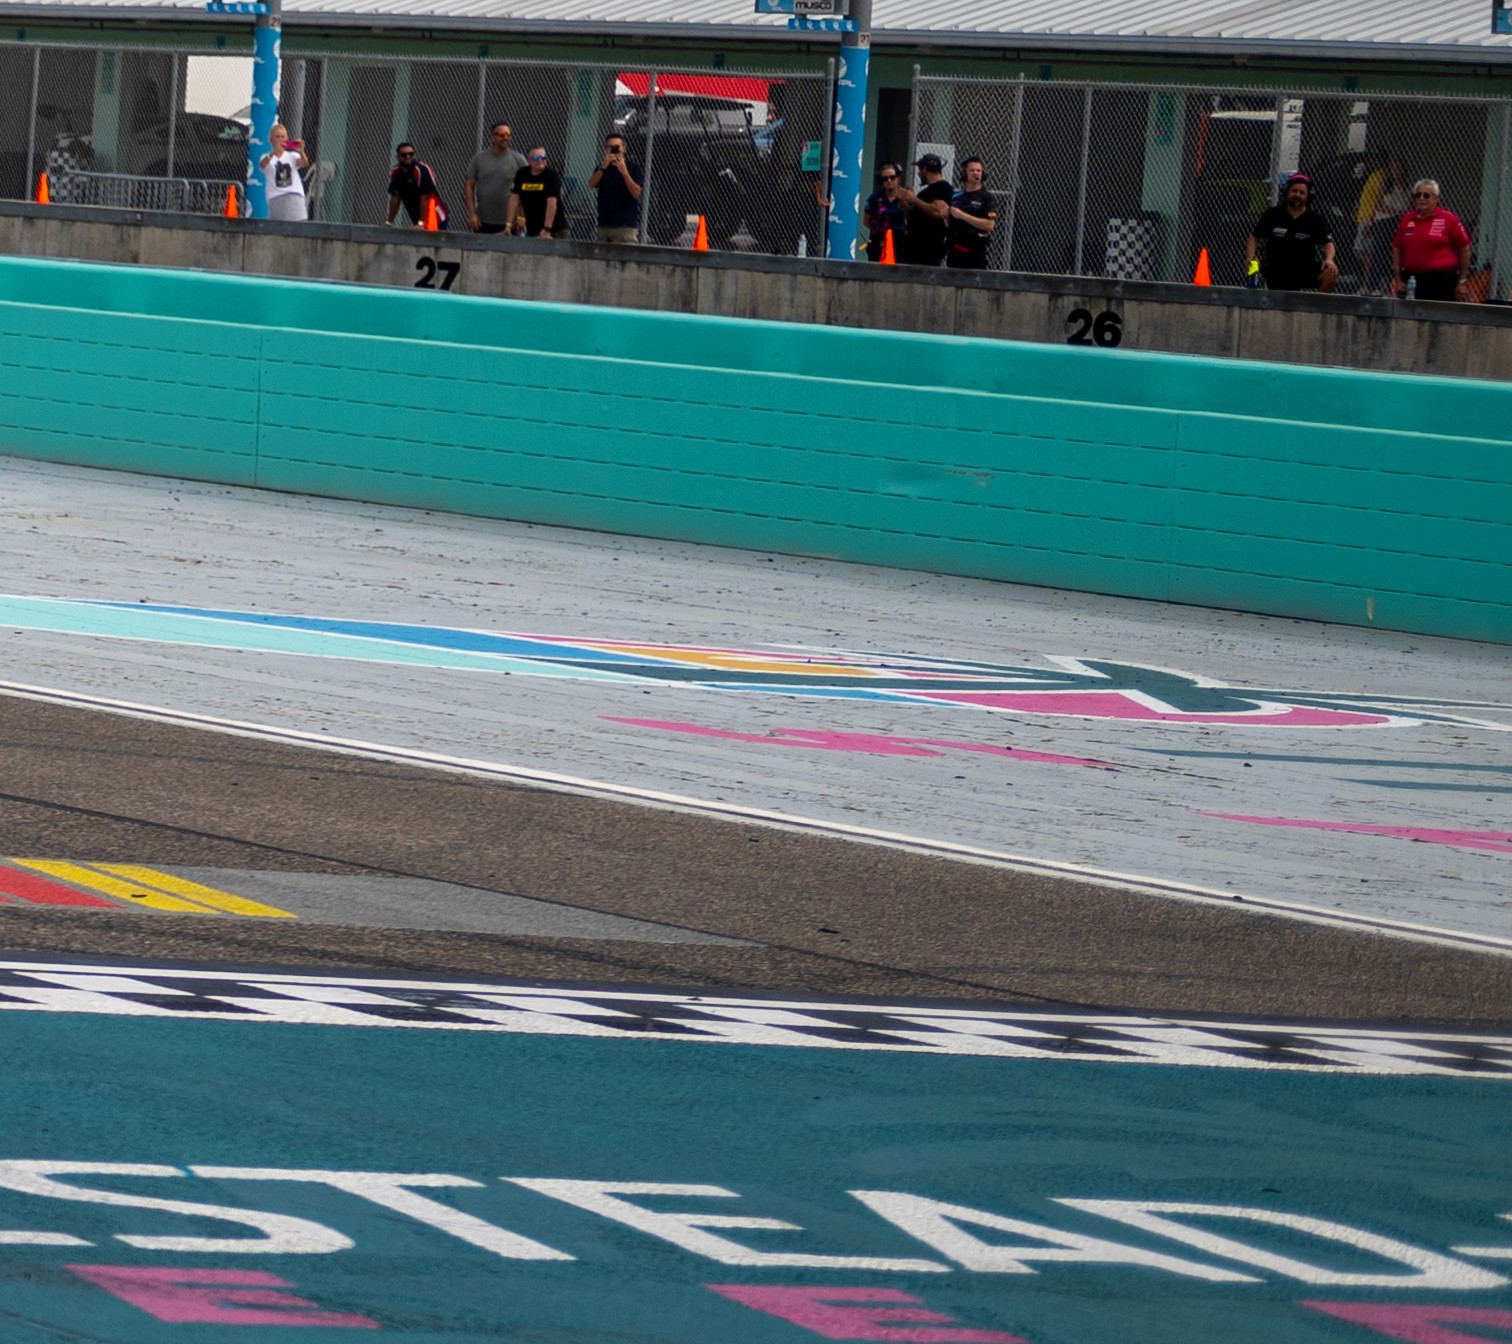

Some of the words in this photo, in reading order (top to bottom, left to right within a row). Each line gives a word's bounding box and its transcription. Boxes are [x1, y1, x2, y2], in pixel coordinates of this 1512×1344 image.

[795, 0, 832, 11] musco
[414, 256, 461, 291] 27
[1067, 308, 1126, 348] 26
